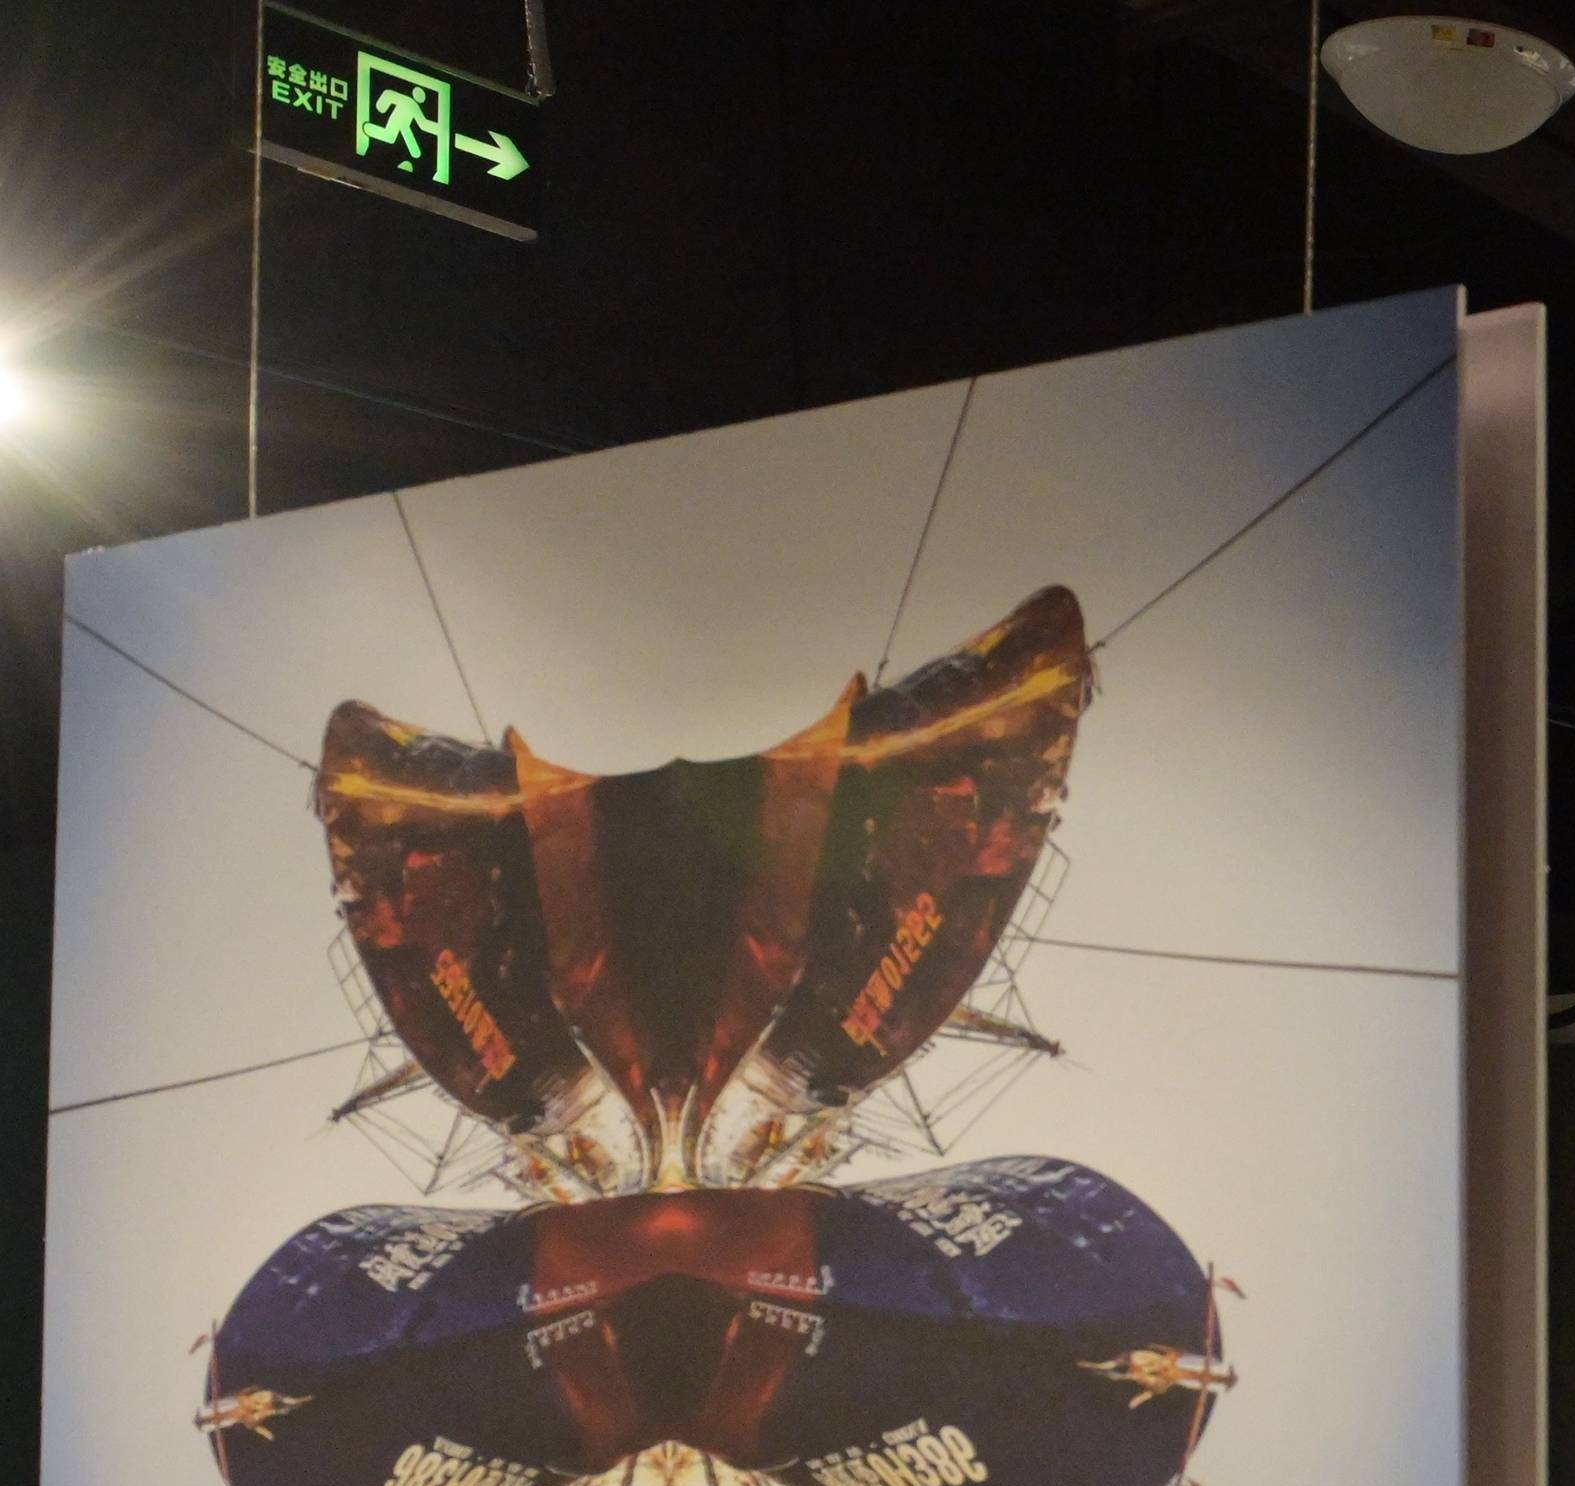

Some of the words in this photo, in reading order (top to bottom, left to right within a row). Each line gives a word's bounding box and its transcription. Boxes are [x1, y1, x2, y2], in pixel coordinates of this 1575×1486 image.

[267, 55, 348, 101] 安全出口
[272, 80, 344, 120] EXIT
